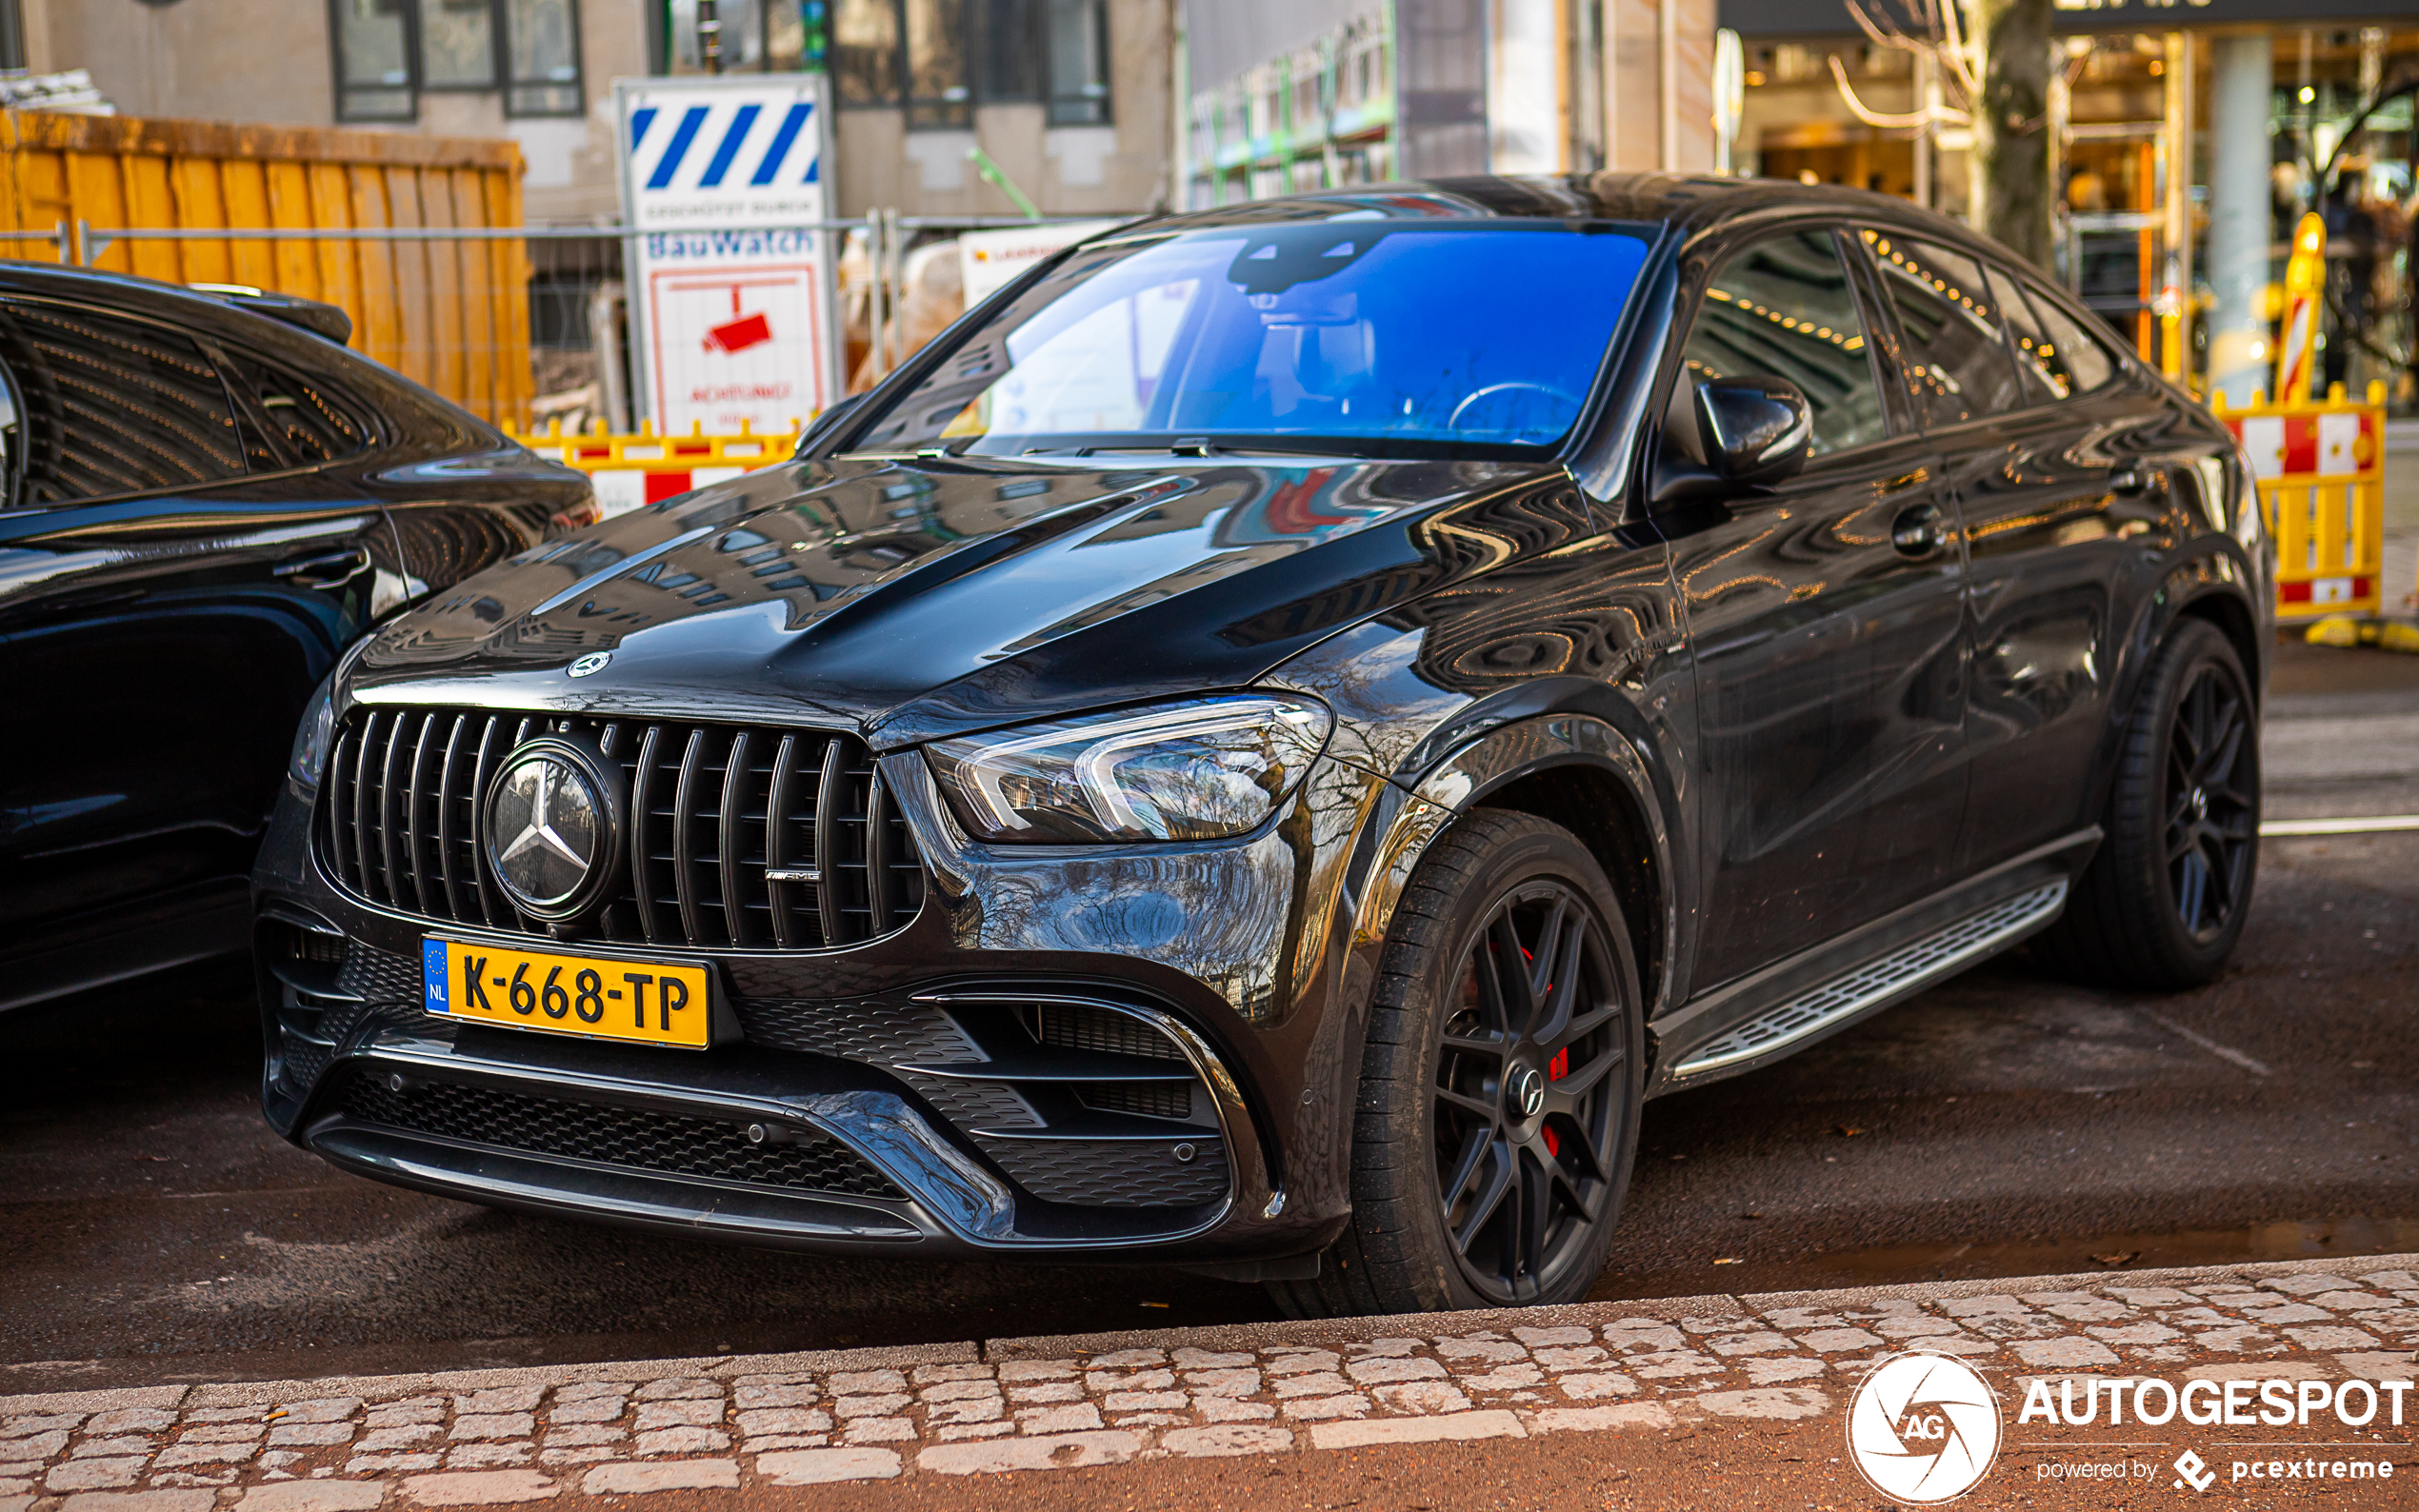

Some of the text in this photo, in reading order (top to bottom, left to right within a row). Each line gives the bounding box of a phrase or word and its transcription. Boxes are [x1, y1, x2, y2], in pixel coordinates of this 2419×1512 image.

[649, 228, 813, 258] BauWatch
[430, 984, 446, 1002] NL
[464, 955, 689, 1031] K-668-TP
